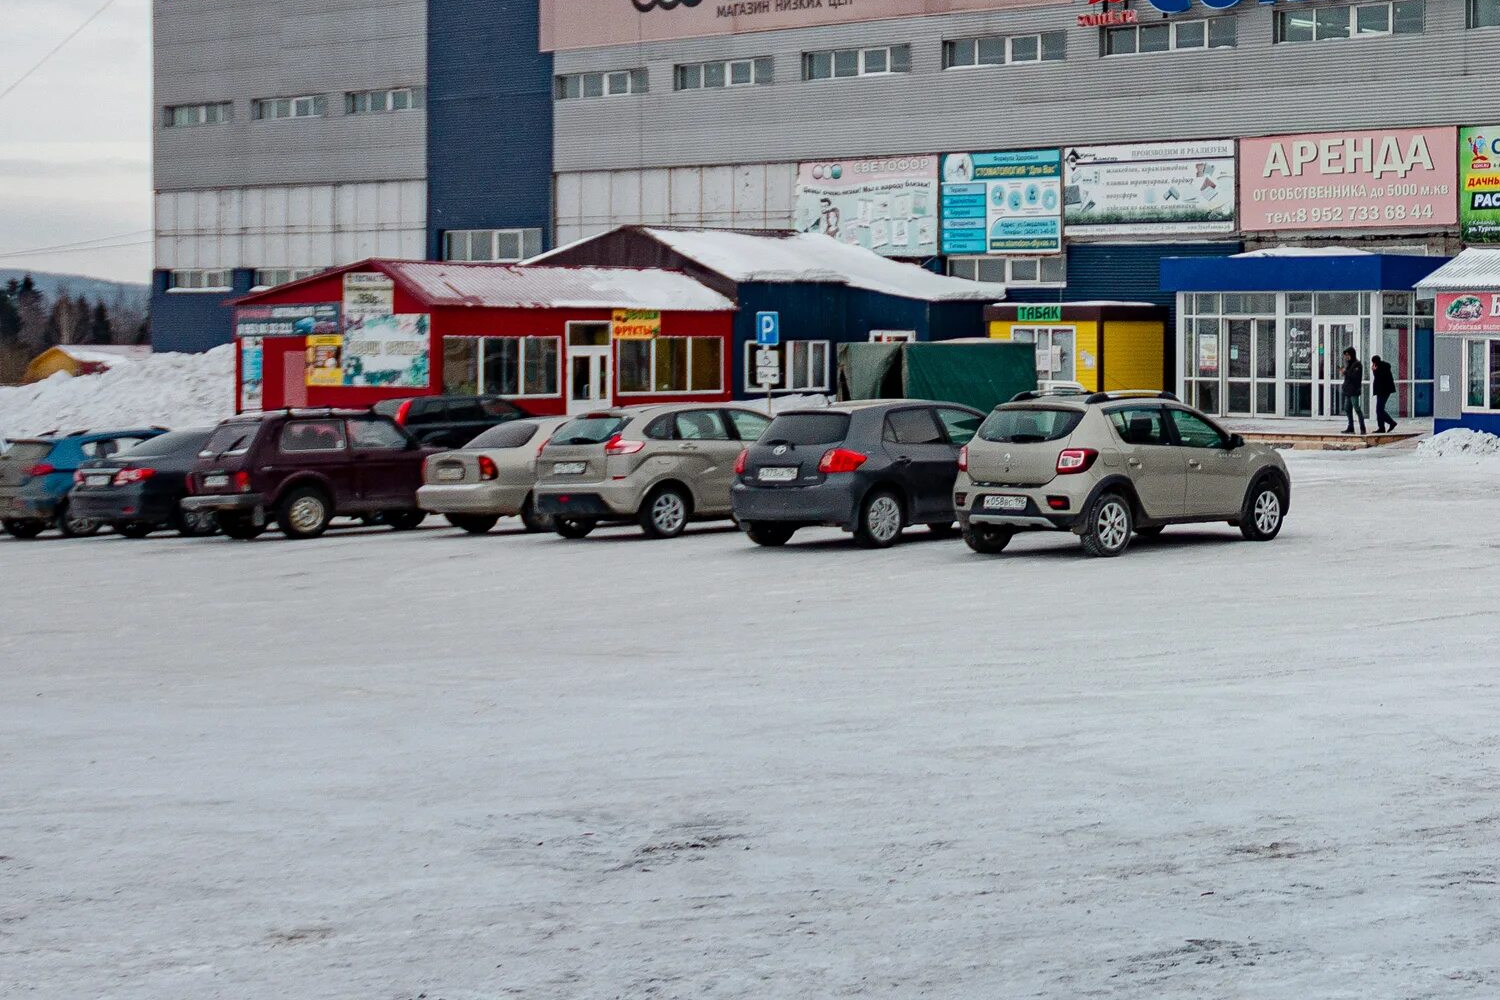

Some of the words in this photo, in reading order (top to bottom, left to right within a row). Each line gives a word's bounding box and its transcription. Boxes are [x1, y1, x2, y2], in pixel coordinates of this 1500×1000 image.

[716, 0, 769, 18] МАГАЗИН
[1263, 135, 1435, 179] АРЕНДА
[853, 158, 929, 174] СВЕТОФОР
[1253, 188, 1268, 201] ОТ
[1270, 184, 1367, 200] СОБСТВЕННИКА
[1370, 186, 1384, 198] до
[1387, 184, 1417, 197] 5000
[1311, 207, 1343, 222] 952
[1348, 206, 1380, 220] 733
[1384, 204, 1406, 219] 68
[1410, 203, 1433, 219] 44
[1020, 306, 1059, 320] ТАБАК
